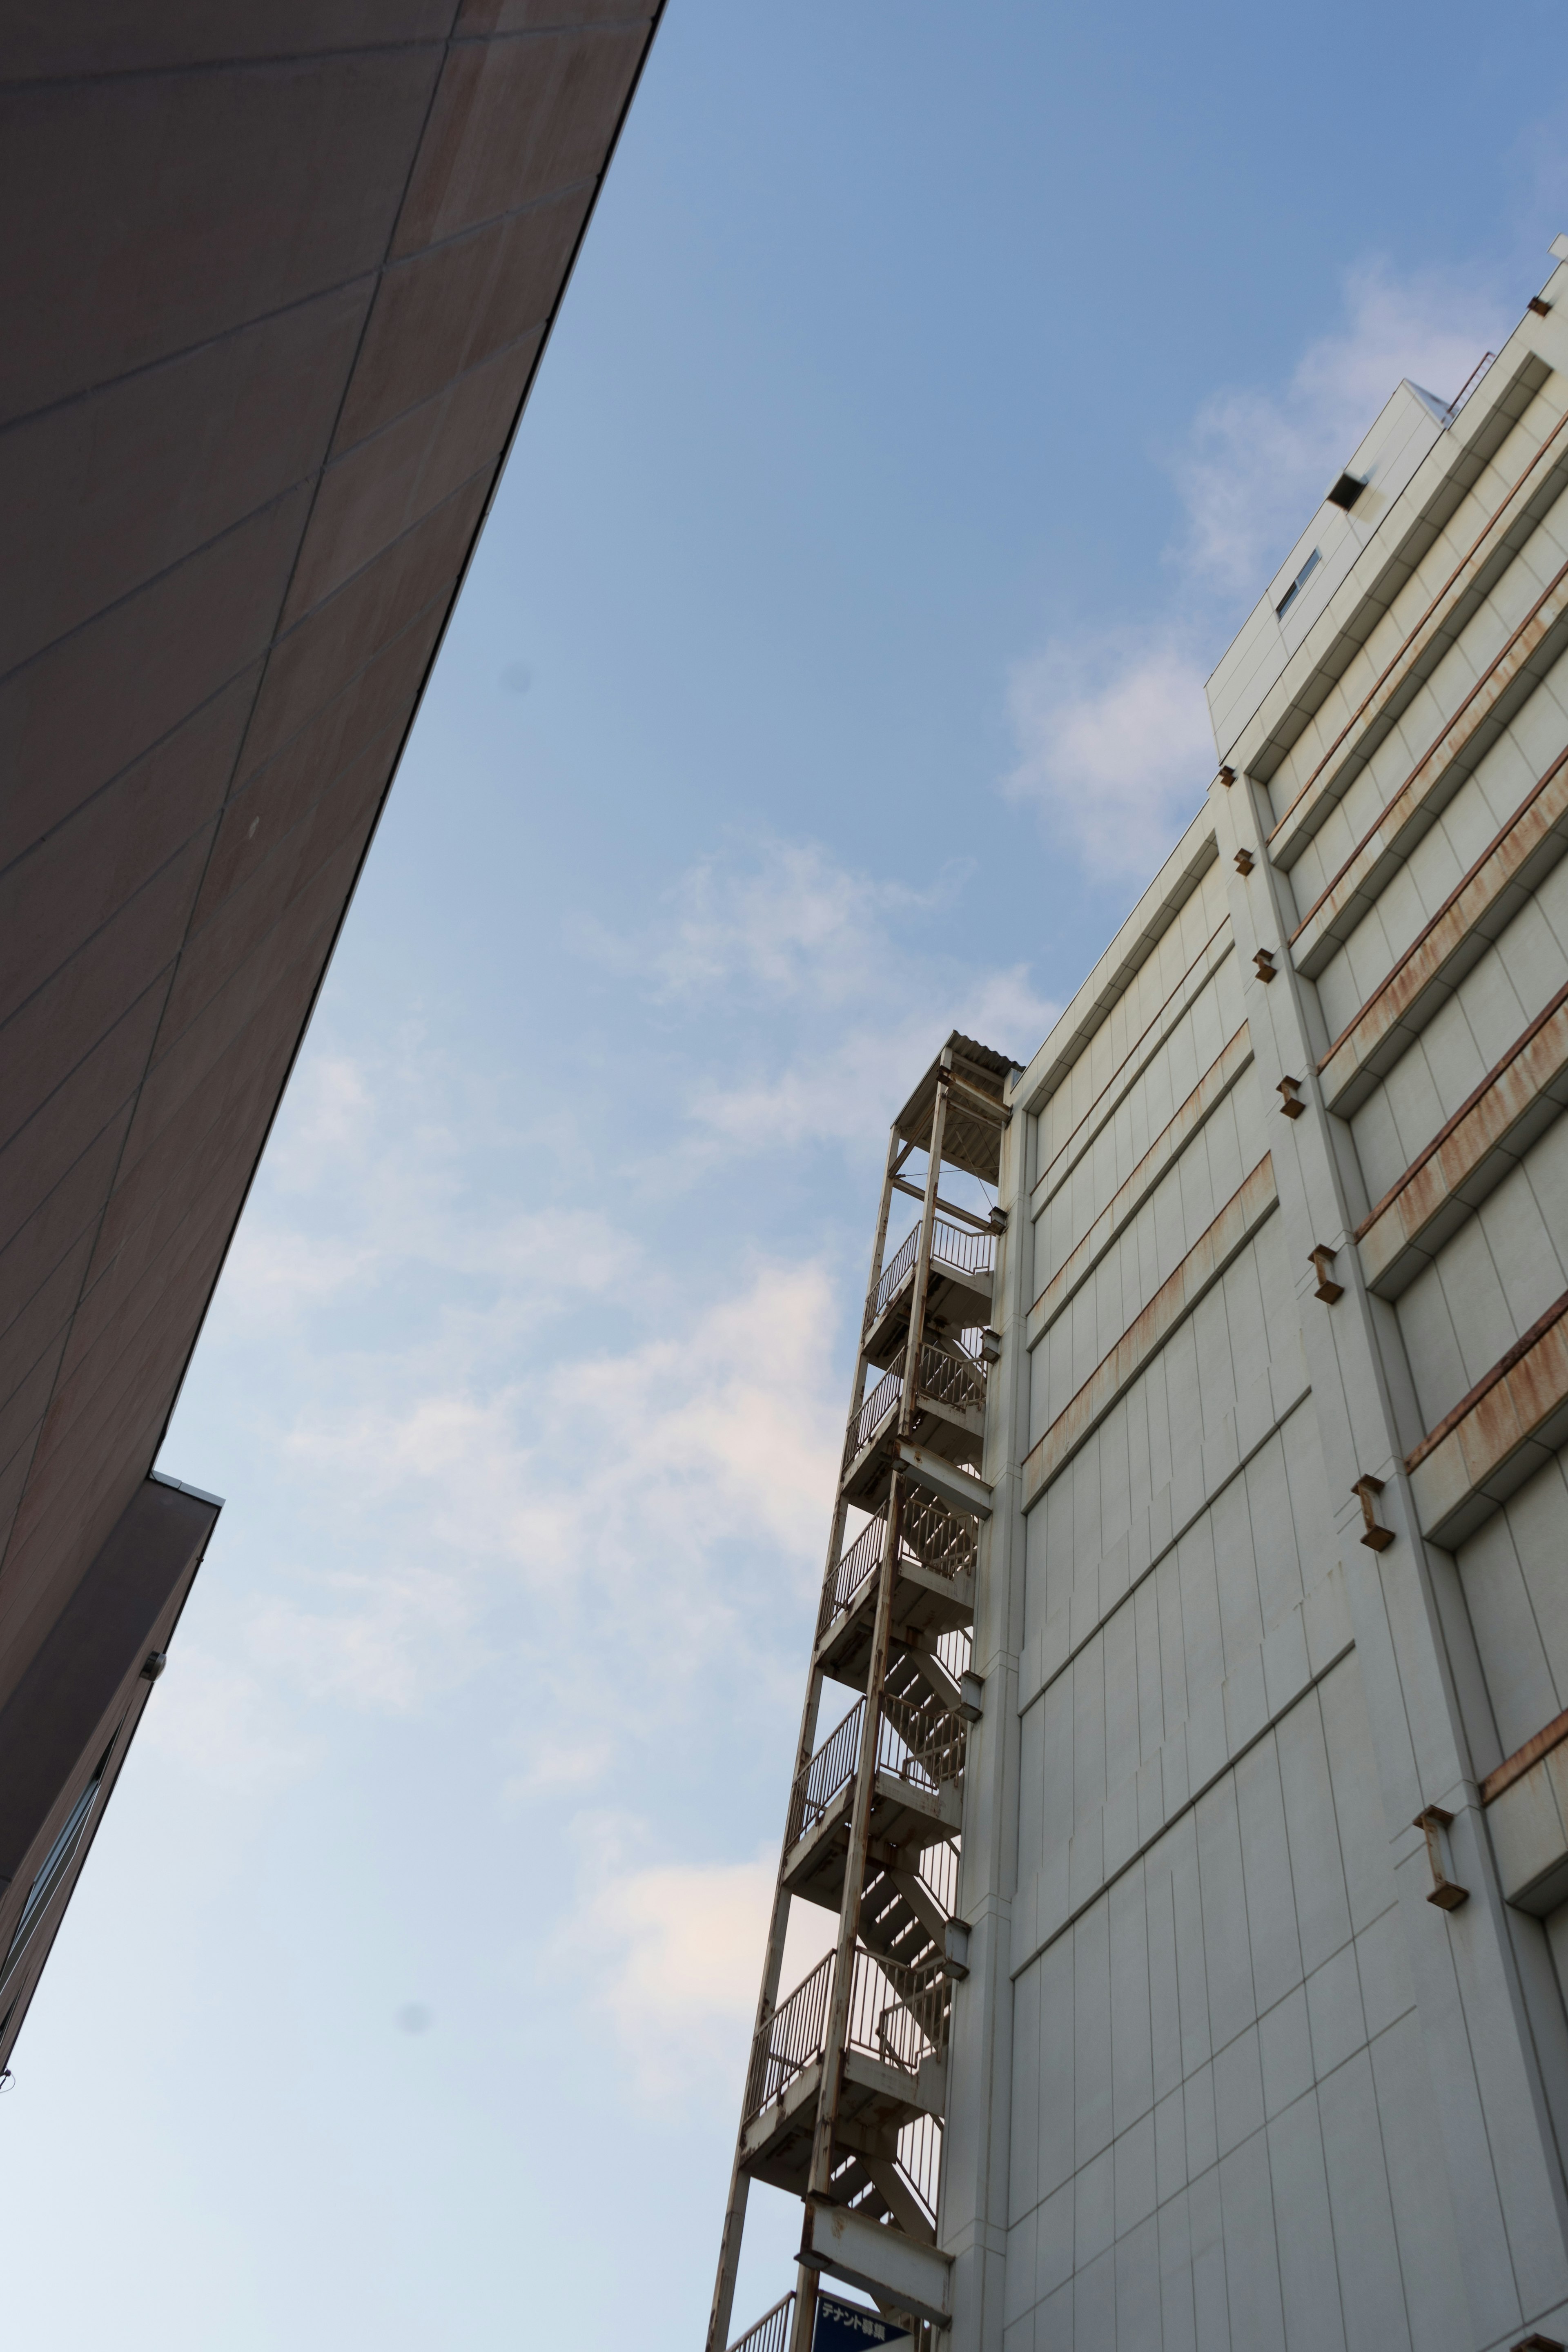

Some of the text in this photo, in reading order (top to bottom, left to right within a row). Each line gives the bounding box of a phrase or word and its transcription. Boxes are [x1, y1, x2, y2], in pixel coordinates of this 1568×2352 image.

[822, 2302, 886, 2341] テナント募集
